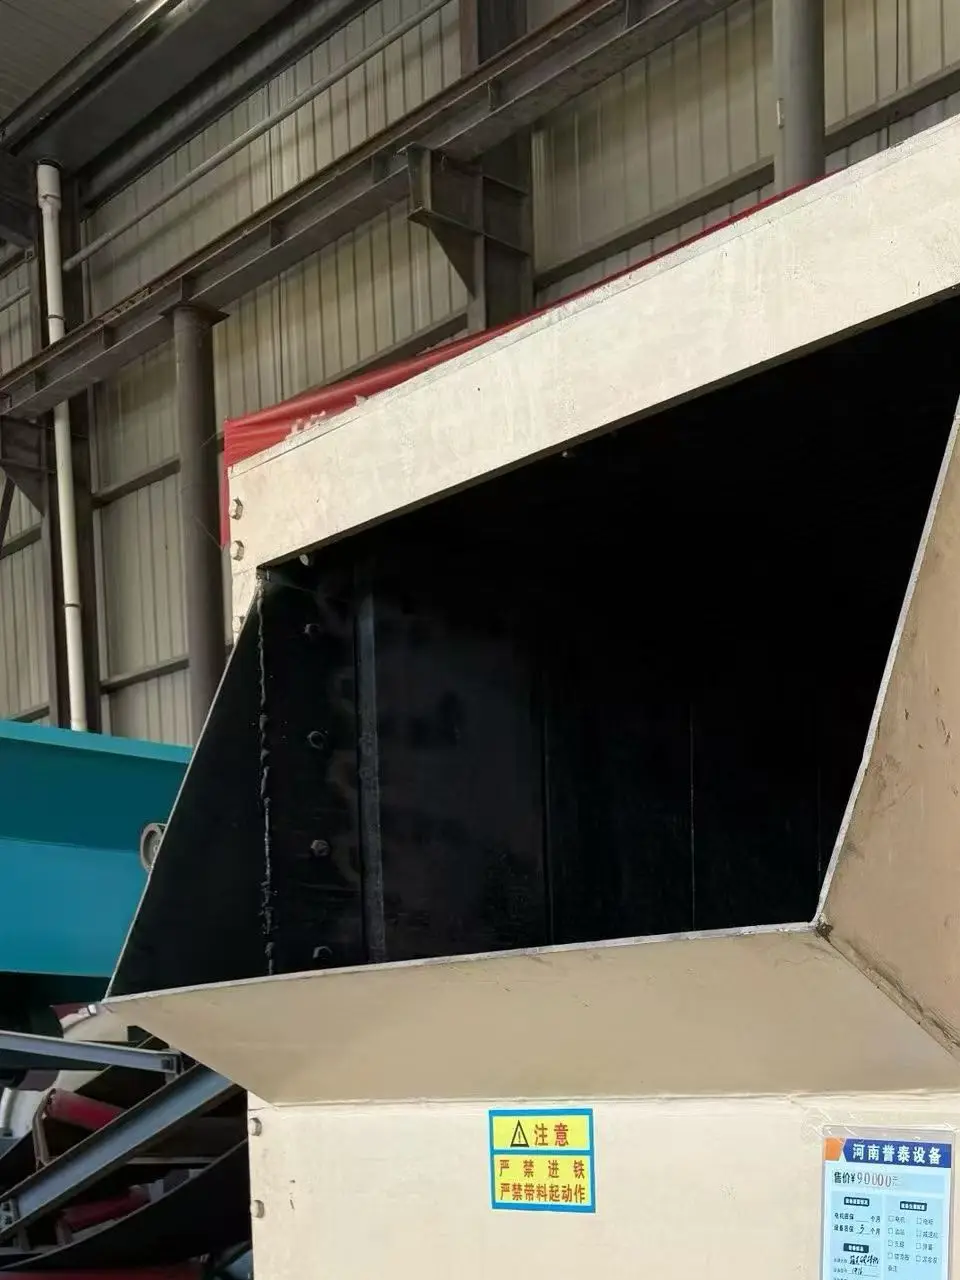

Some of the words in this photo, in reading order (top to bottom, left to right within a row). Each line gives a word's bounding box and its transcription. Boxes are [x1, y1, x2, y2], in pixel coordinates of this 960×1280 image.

[534, 1122, 569, 1147] 注意
[498, 1159, 585, 1179] 严禁进铁
[499, 1182, 586, 1204] 严禁带料起动作
